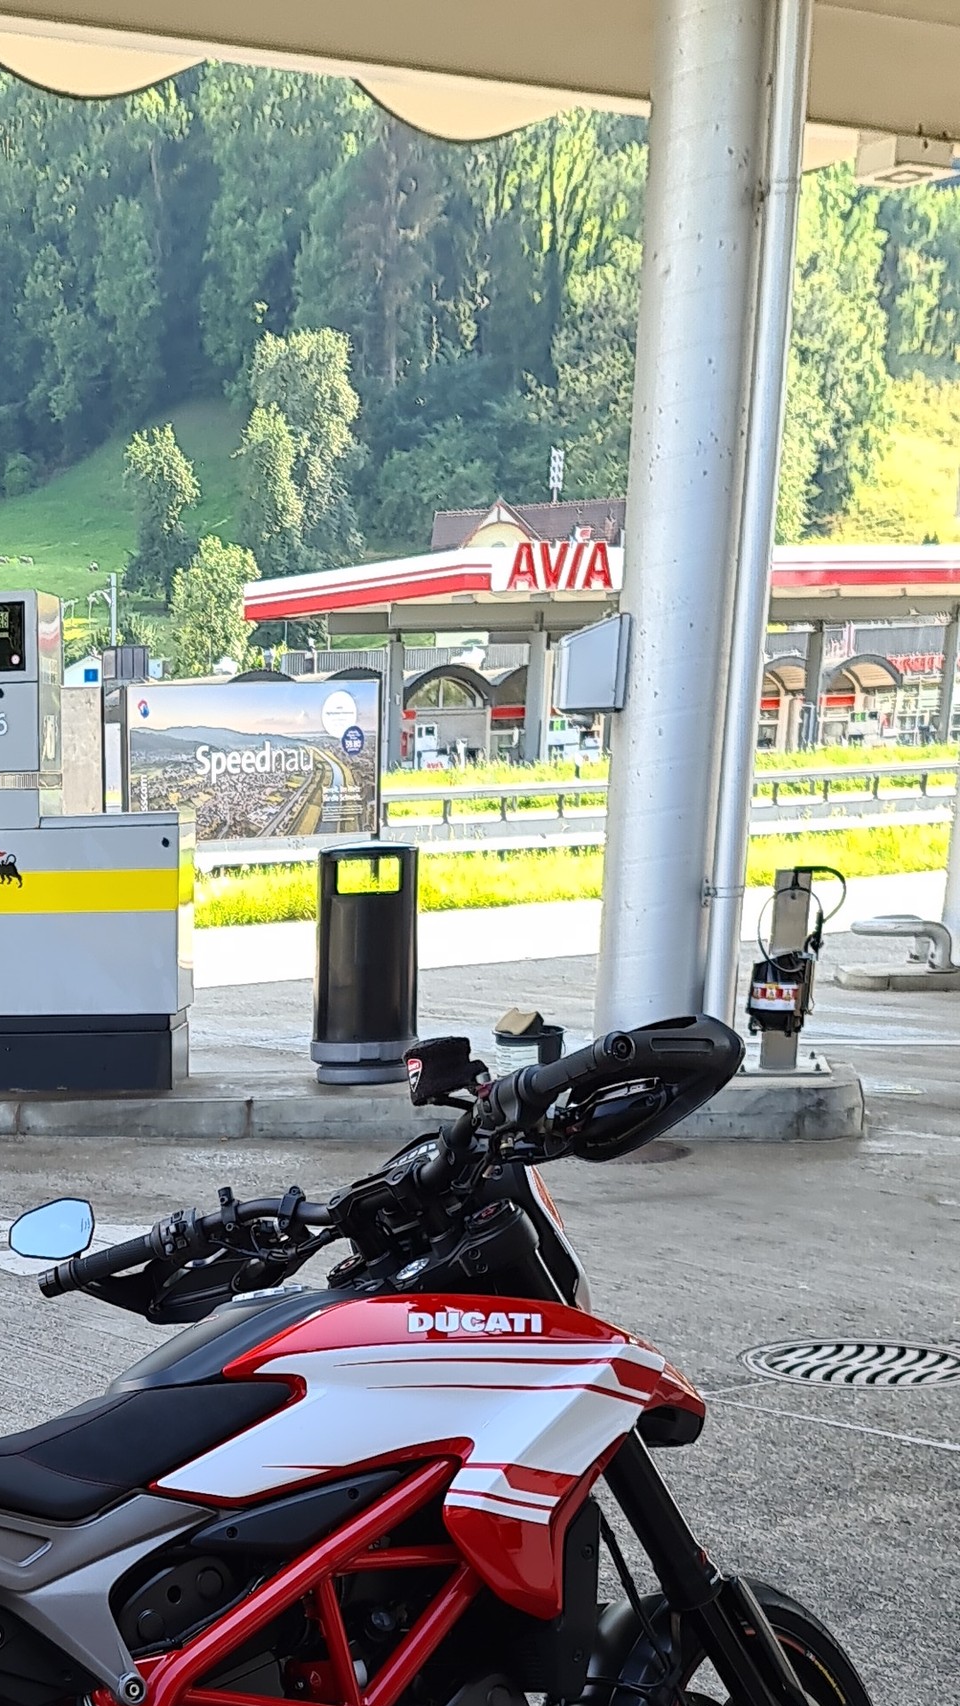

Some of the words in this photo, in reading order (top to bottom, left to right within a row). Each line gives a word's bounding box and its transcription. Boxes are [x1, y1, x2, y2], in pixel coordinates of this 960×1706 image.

[506, 540, 613, 591] AVIA
[196, 740, 314, 785] Speednau
[408, 1312, 543, 1333] DUCATI
